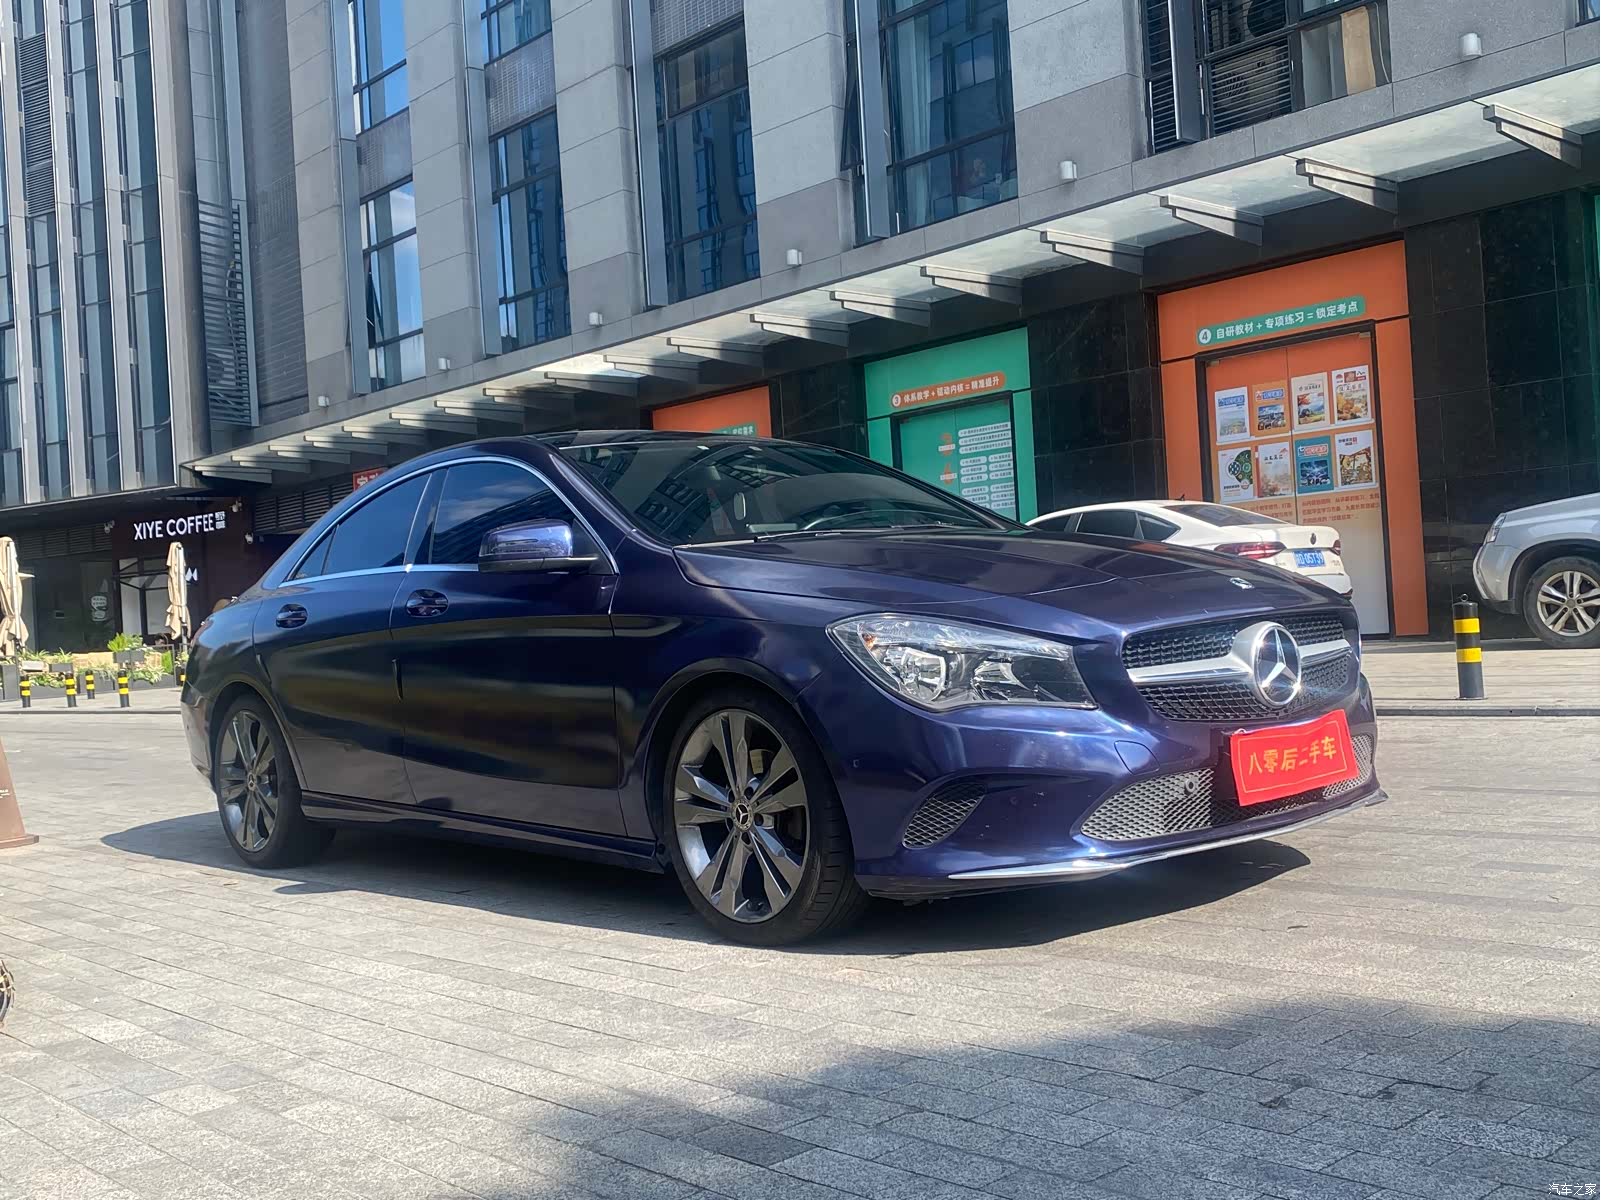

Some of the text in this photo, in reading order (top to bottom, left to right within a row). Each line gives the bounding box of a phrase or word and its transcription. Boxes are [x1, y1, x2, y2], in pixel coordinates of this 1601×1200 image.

[1216, 322, 1254, 339] 自研教材
[1264, 312, 1305, 329] 专项练习
[1316, 301, 1359, 319] 锁定考点
[133, 520, 164, 541] XIYE
[166, 512, 215, 536] COFFEE
[1248, 736, 1337, 776] 八零后二手车
